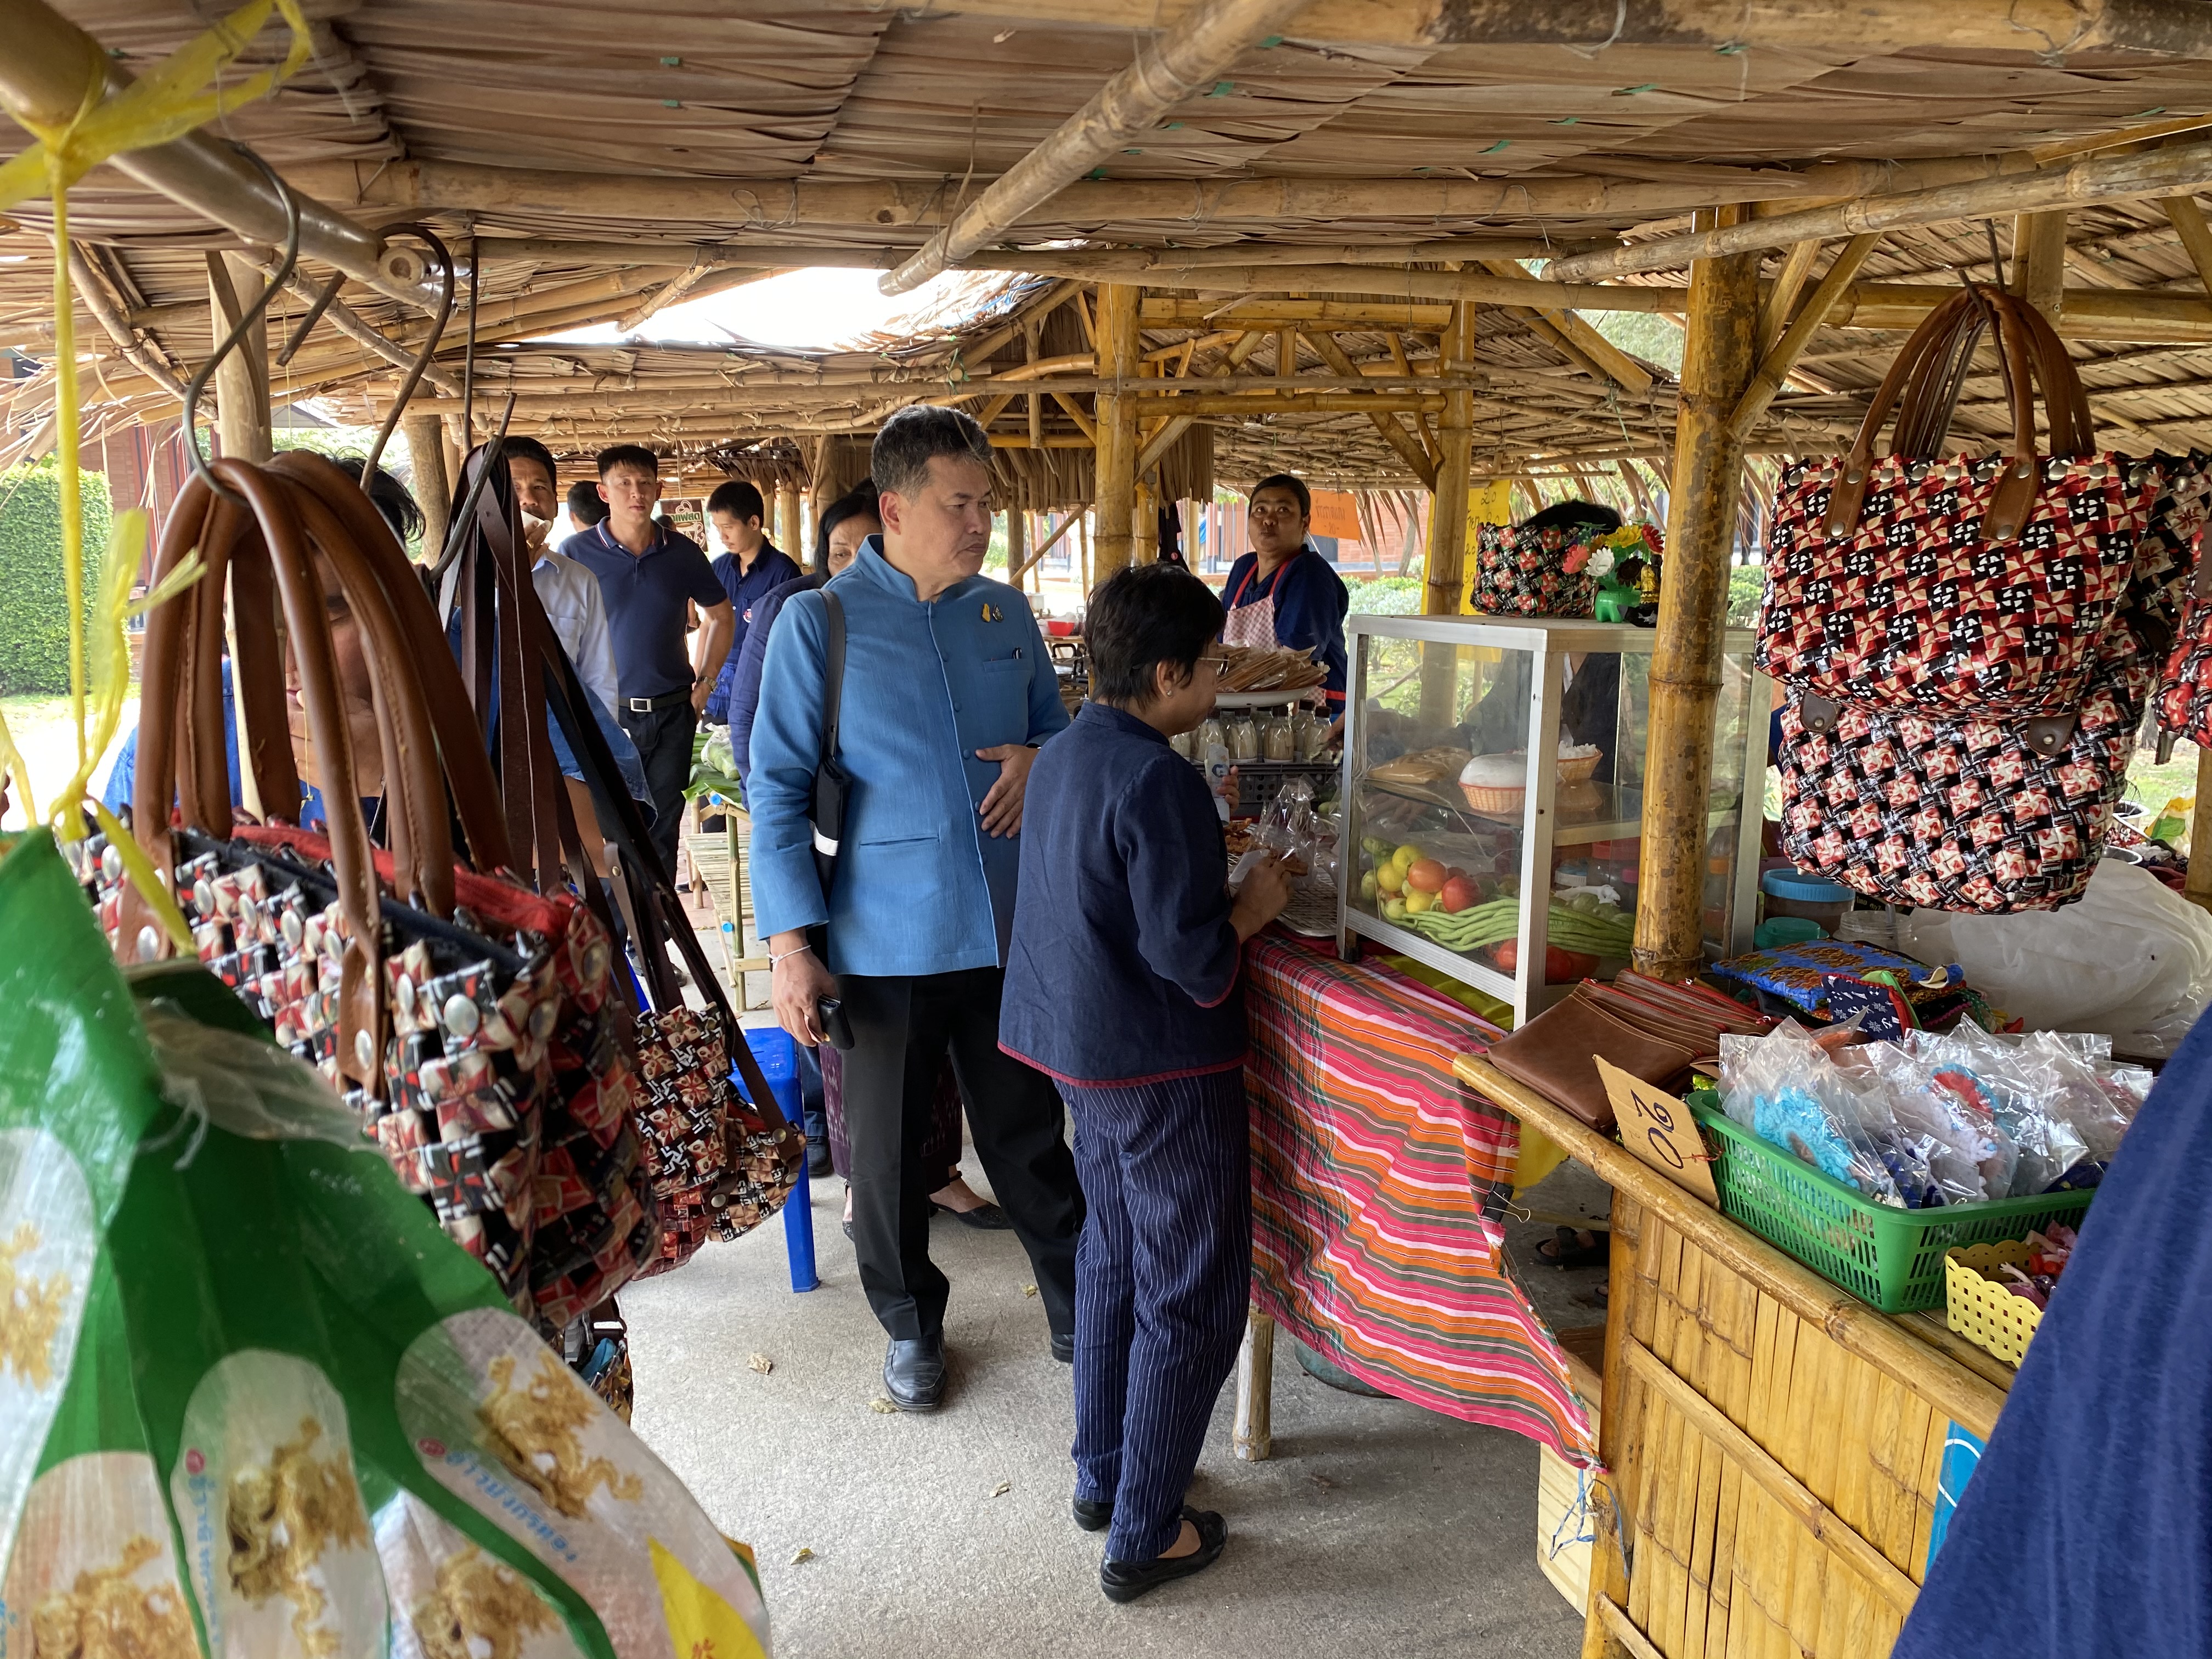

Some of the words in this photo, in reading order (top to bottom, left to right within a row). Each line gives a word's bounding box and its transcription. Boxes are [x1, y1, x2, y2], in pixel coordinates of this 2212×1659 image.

[1481, 487, 1497, 505] 20
[671, 512, 701, 522] าแฟสด
[1465, 543, 1476, 556] 20
